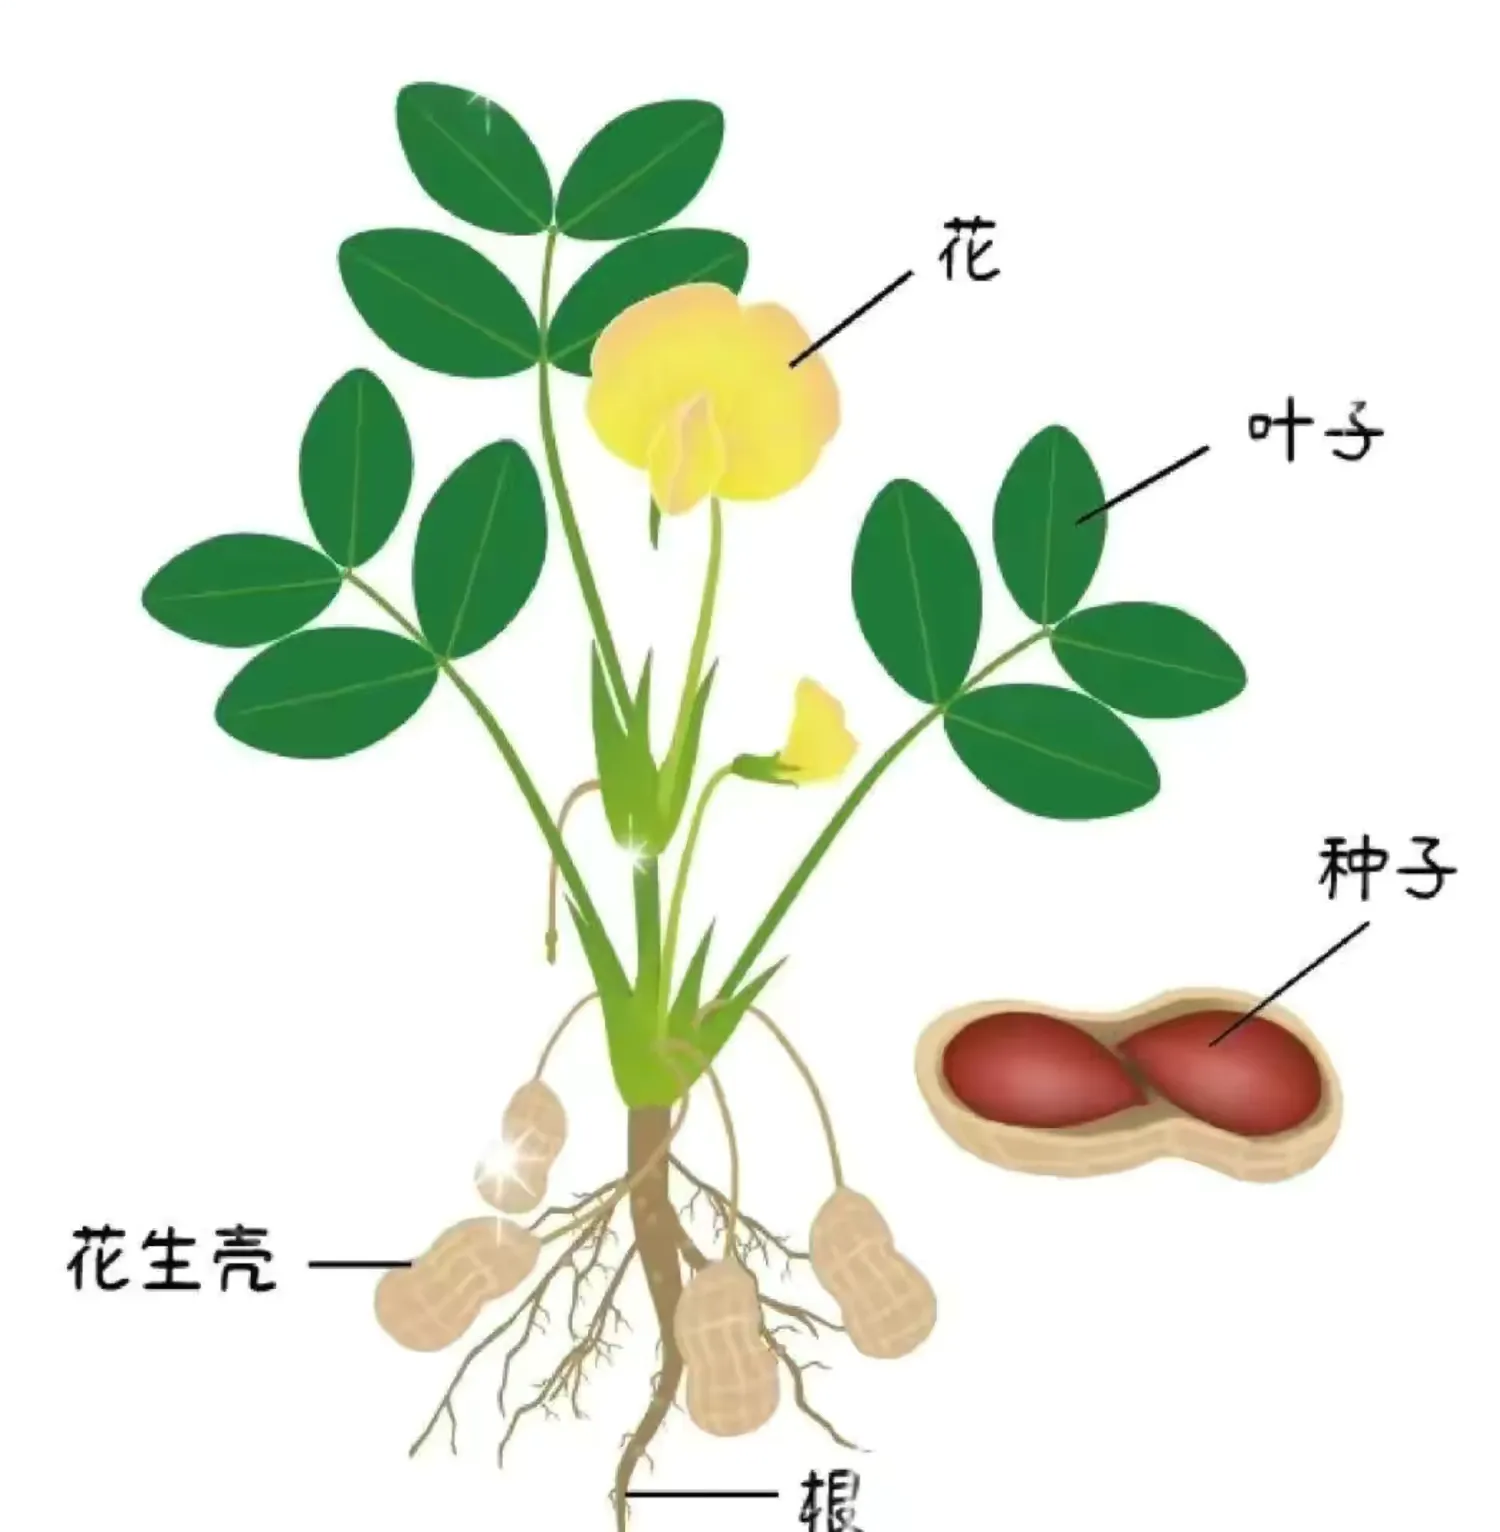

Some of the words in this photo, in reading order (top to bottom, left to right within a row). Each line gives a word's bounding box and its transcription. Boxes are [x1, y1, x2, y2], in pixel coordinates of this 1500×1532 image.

[938, 215, 1001, 282] 花
[1247, 396, 1385, 463] 叶子
[1318, 833, 1458, 902] 种子
[66, 1223, 278, 1293] 花生壳
[799, 1469, 865, 1532] 根
